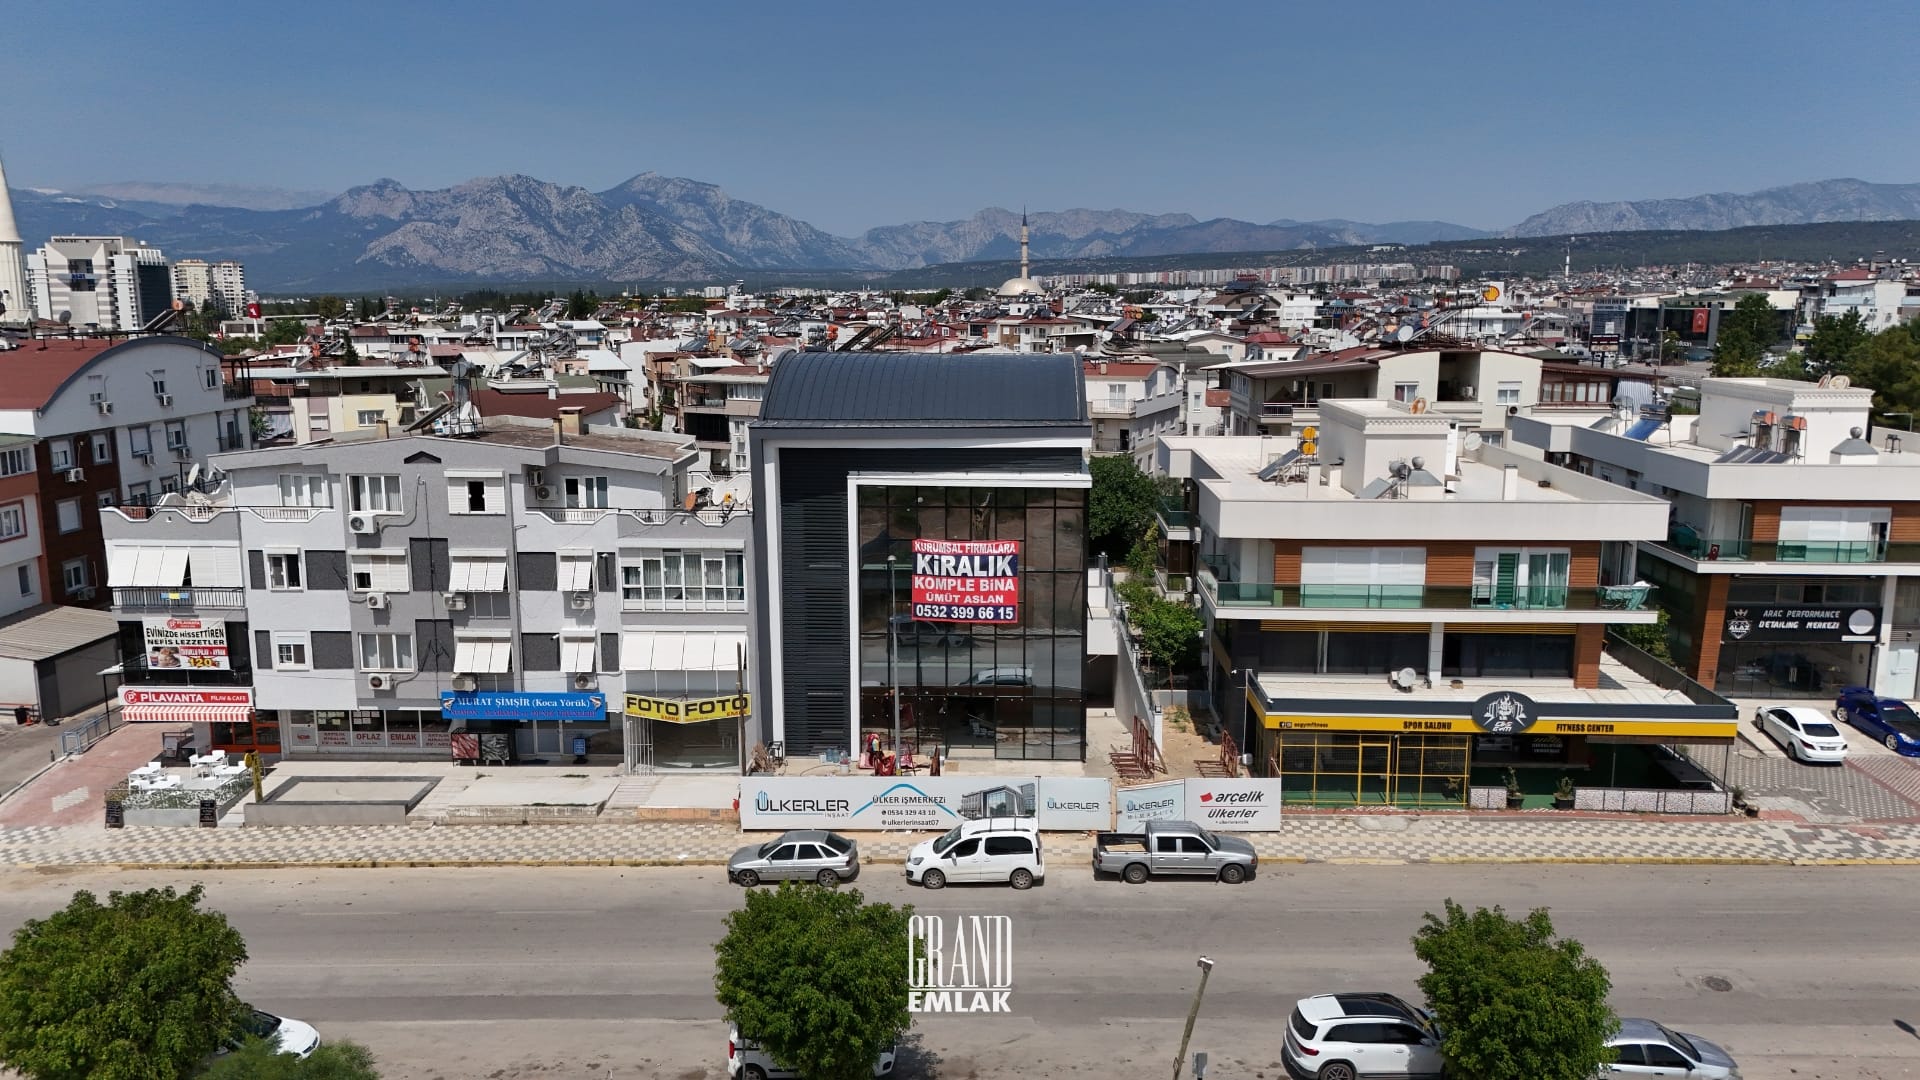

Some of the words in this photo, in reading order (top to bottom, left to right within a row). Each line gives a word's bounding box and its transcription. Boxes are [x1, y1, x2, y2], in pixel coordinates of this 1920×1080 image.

[915, 541, 963, 554] KURUMSAL
[914, 576, 975, 592] KOMPLE
[925, 592, 961, 603] ÜMÜT
[963, 594, 1004, 604] ASLAN
[916, 604, 947, 618] 0532
[950, 606, 975, 619] 399
[978, 606, 994, 619] 66
[998, 607, 1014, 619] 15
[1786, 610, 1841, 618] PERFORMANCE
[1758, 621, 1799, 629] DETAILING
[145, 626, 178, 638] EVİNİZDE
[179, 627, 225, 639] HİSSETTİREN
[189, 658, 212, 668] 120
[140, 691, 204, 702] PİLAVANTA
[457, 697, 493, 706] MURAT
[495, 696, 530, 708] ŞİMŞİR
[531, 698, 557, 707] (Koca
[560, 698, 590, 707] Yörük)
[626, 696, 680, 716] FOTO
[684, 696, 748, 717] FOTO
[1403, 720, 1423, 729] SPOR
[1424, 721, 1452, 730] SALONU
[1556, 723, 1585, 732] FITNESS
[1586, 724, 1614, 732] CENTER
[356, 733, 381, 741] OFLAZ
[872, 795, 899, 804] ÜLKER
[1215, 791, 1264, 805] arçelik
[1207, 808, 1259, 818] ülkerler
